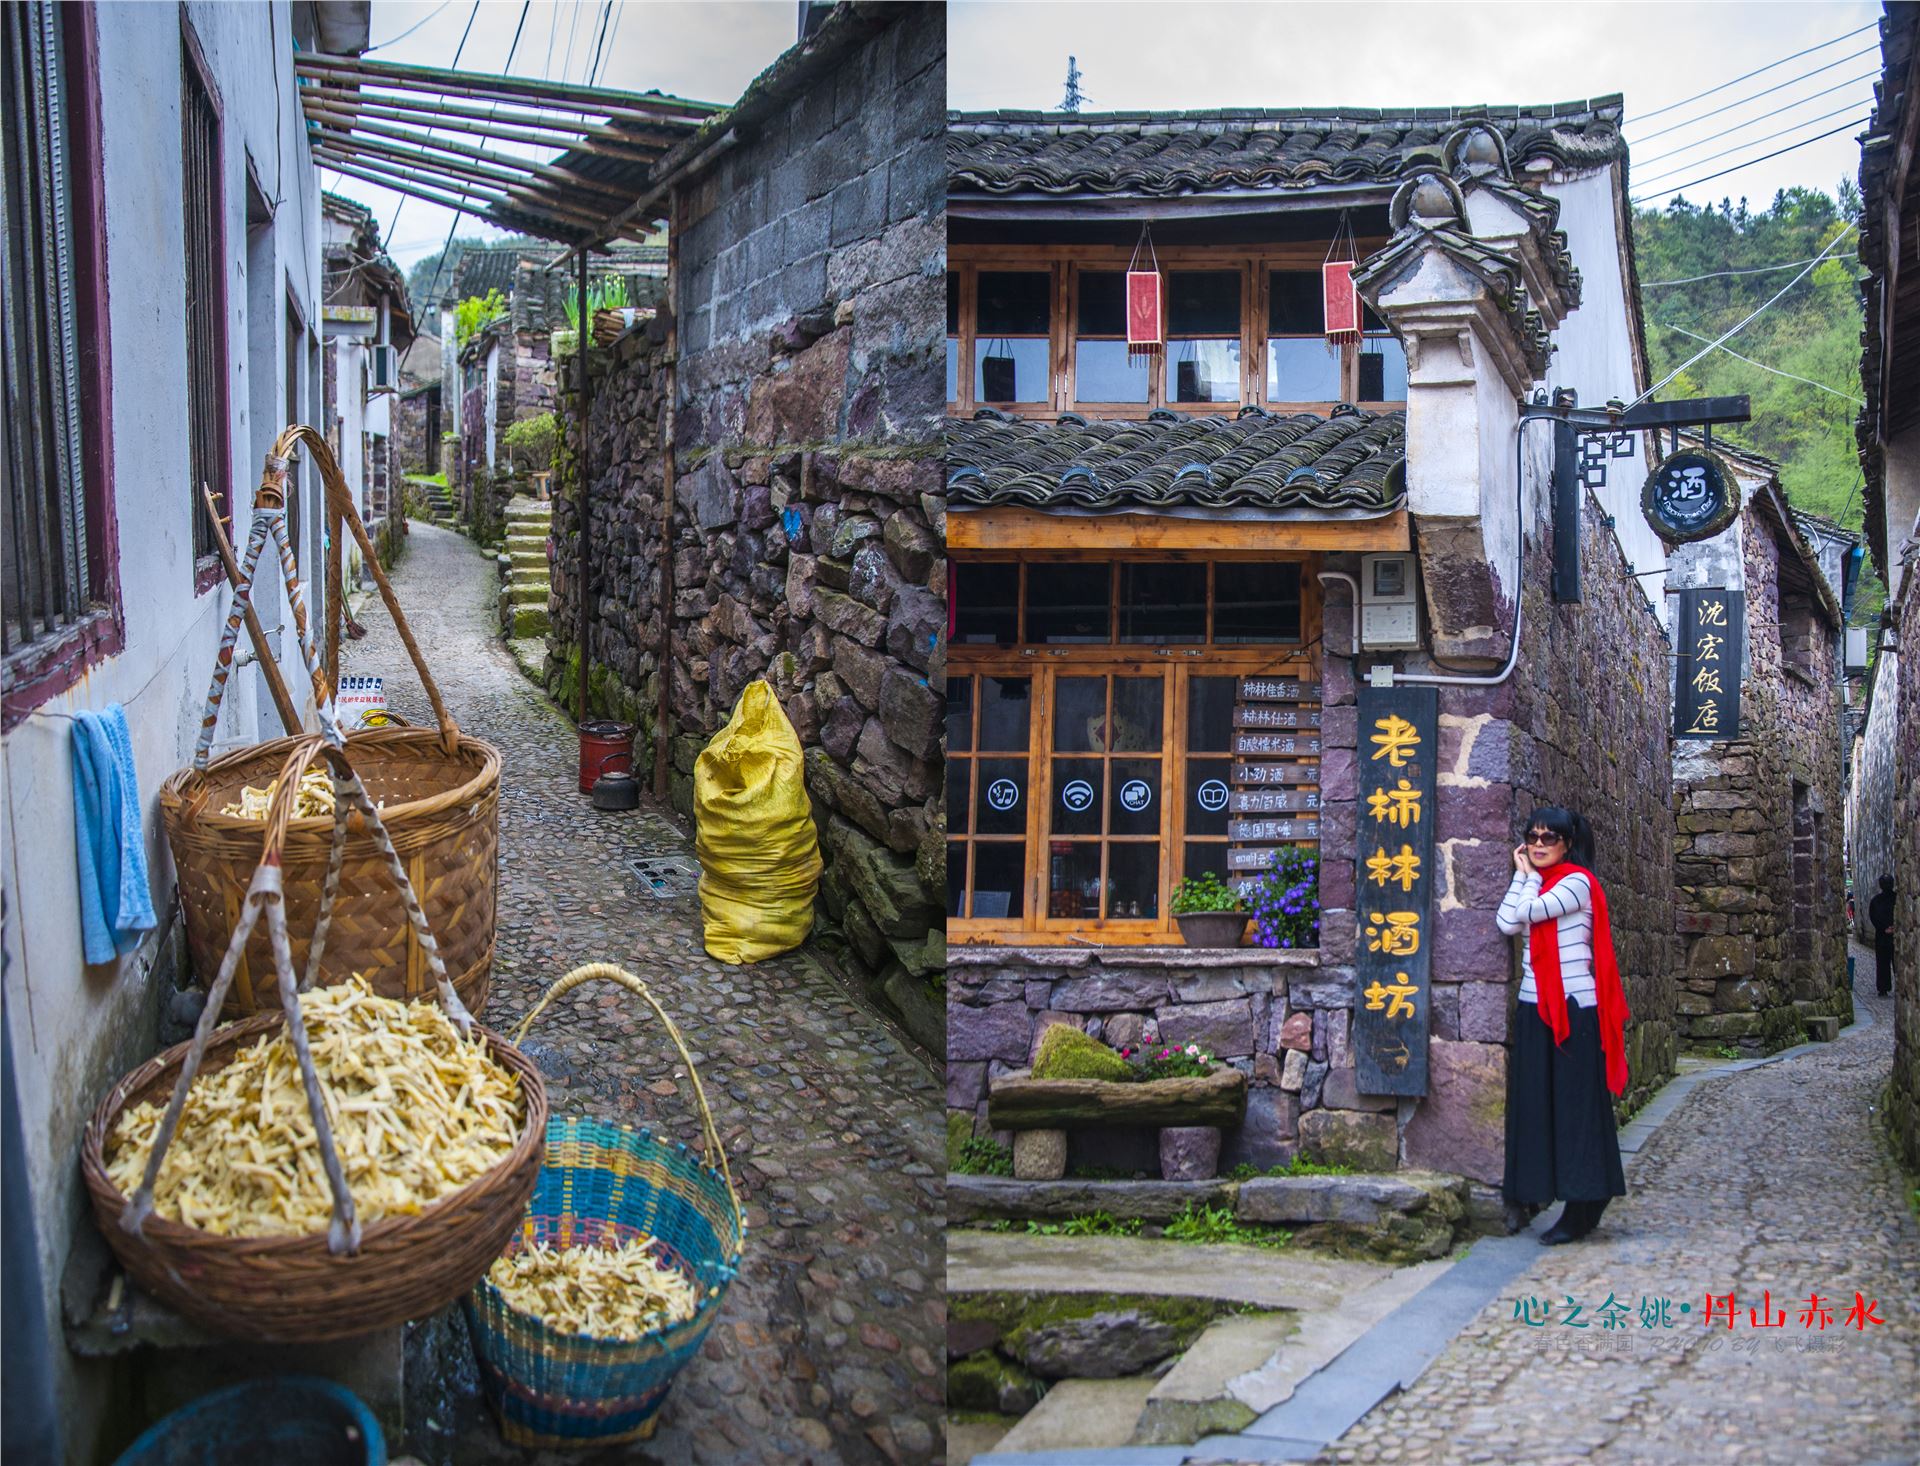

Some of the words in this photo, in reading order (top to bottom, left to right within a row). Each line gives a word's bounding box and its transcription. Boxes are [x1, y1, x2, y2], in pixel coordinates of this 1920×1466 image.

[1669, 466, 1706, 499] 酒
[1692, 600, 1728, 728] 沈宏饭店
[1310, 713, 1321, 726] 元
[1309, 741, 1320, 752] 元
[1307, 768, 1318, 780] 元
[1307, 795, 1318, 808] 元
[1307, 823, 1318, 835] 元
[1363, 713, 1422, 1019] 老柿林酒坊
